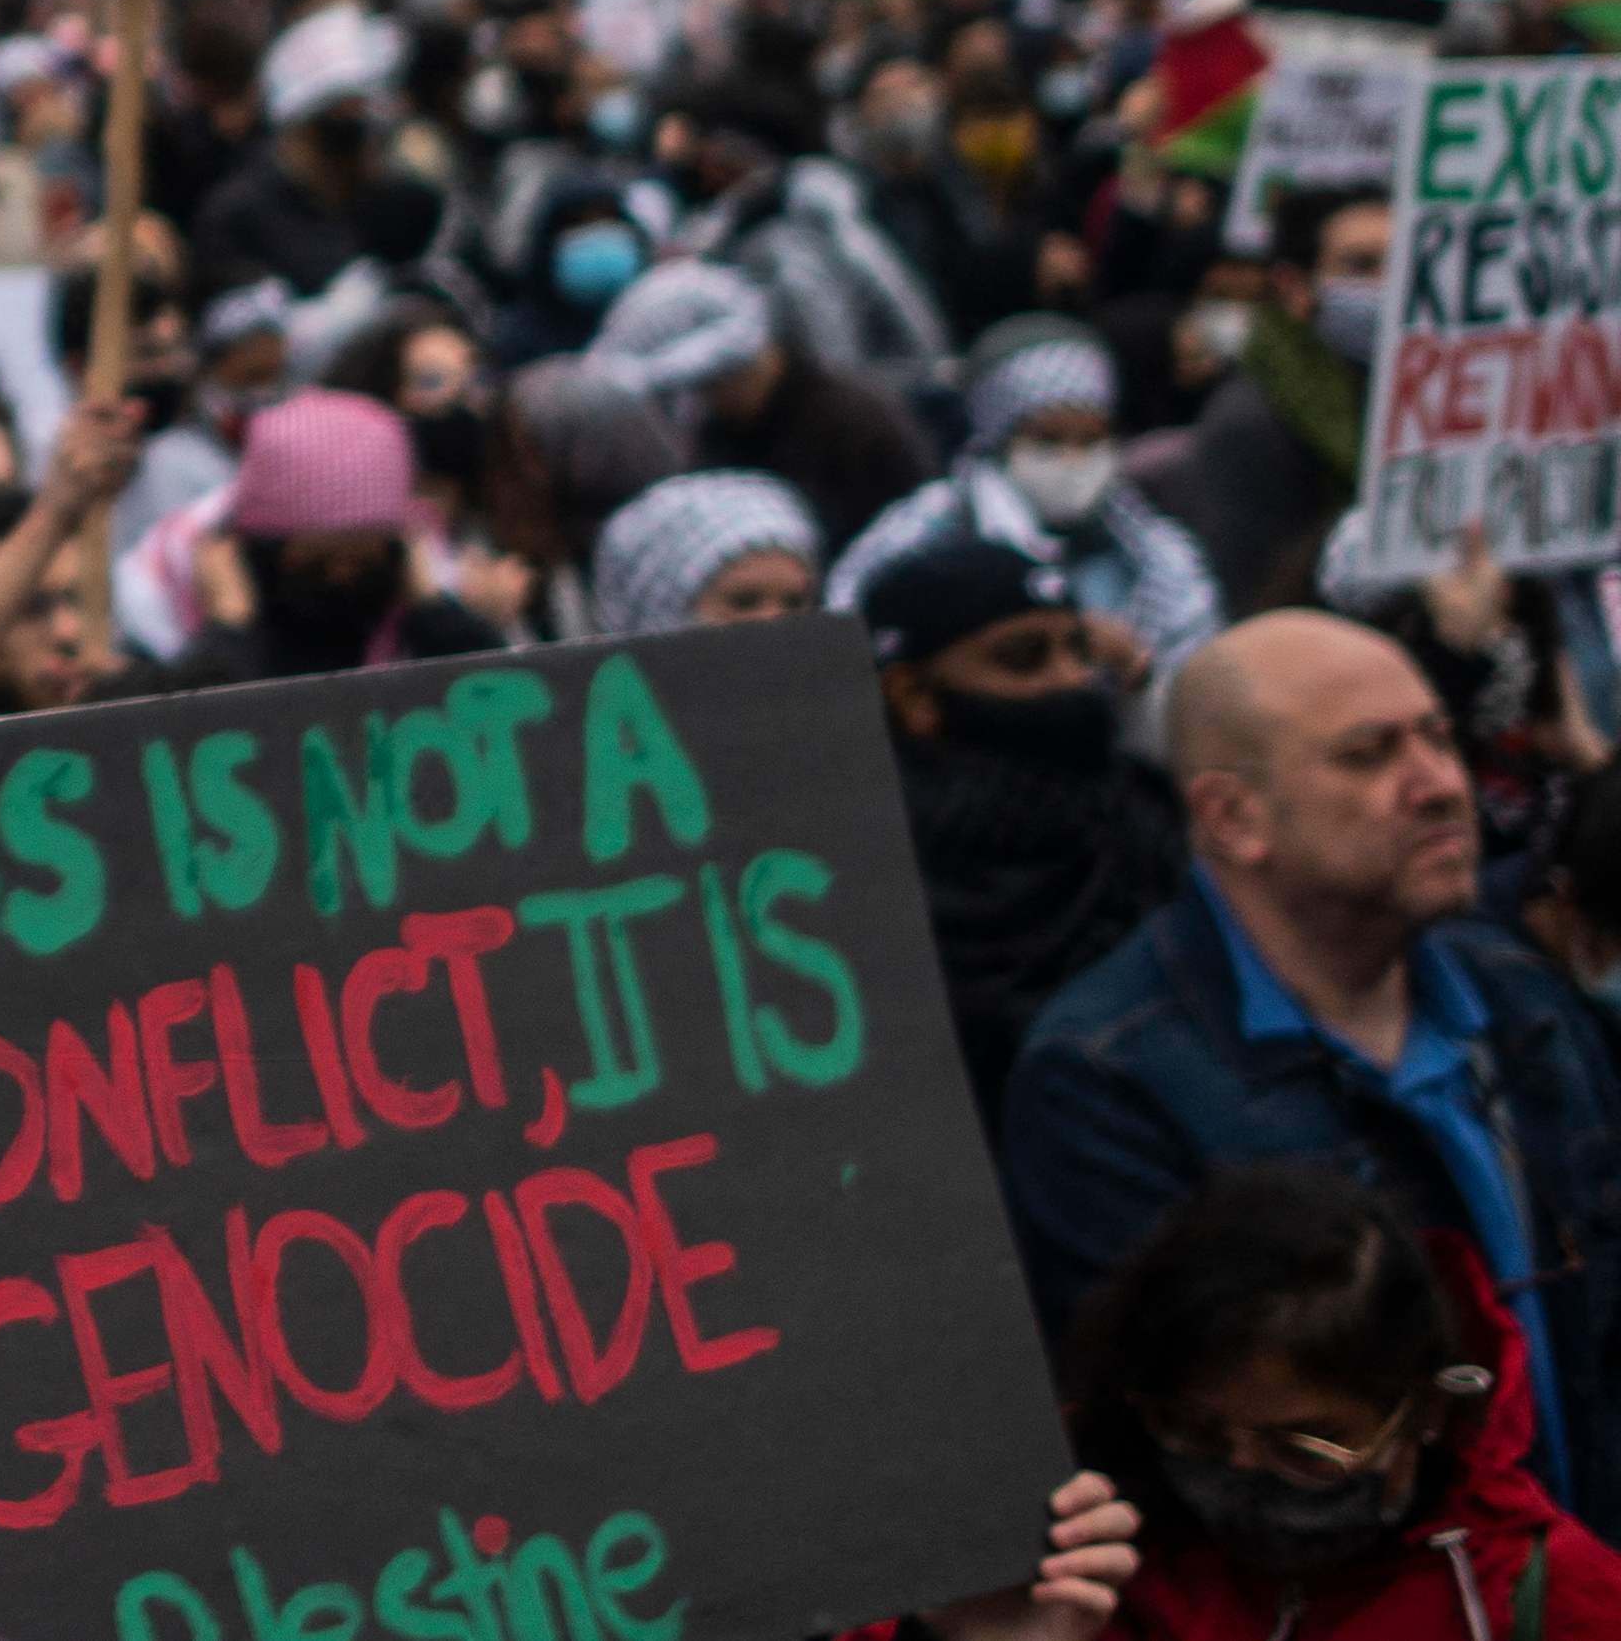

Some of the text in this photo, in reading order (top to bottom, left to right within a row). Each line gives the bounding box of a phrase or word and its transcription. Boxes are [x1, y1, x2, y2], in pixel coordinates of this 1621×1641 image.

[141, 731, 282, 920] IS
[301, 669, 553, 918] NOT
[582, 653, 713, 864] A
[516, 874, 687, 1110] IT
[699, 848, 864, 1092] IS
